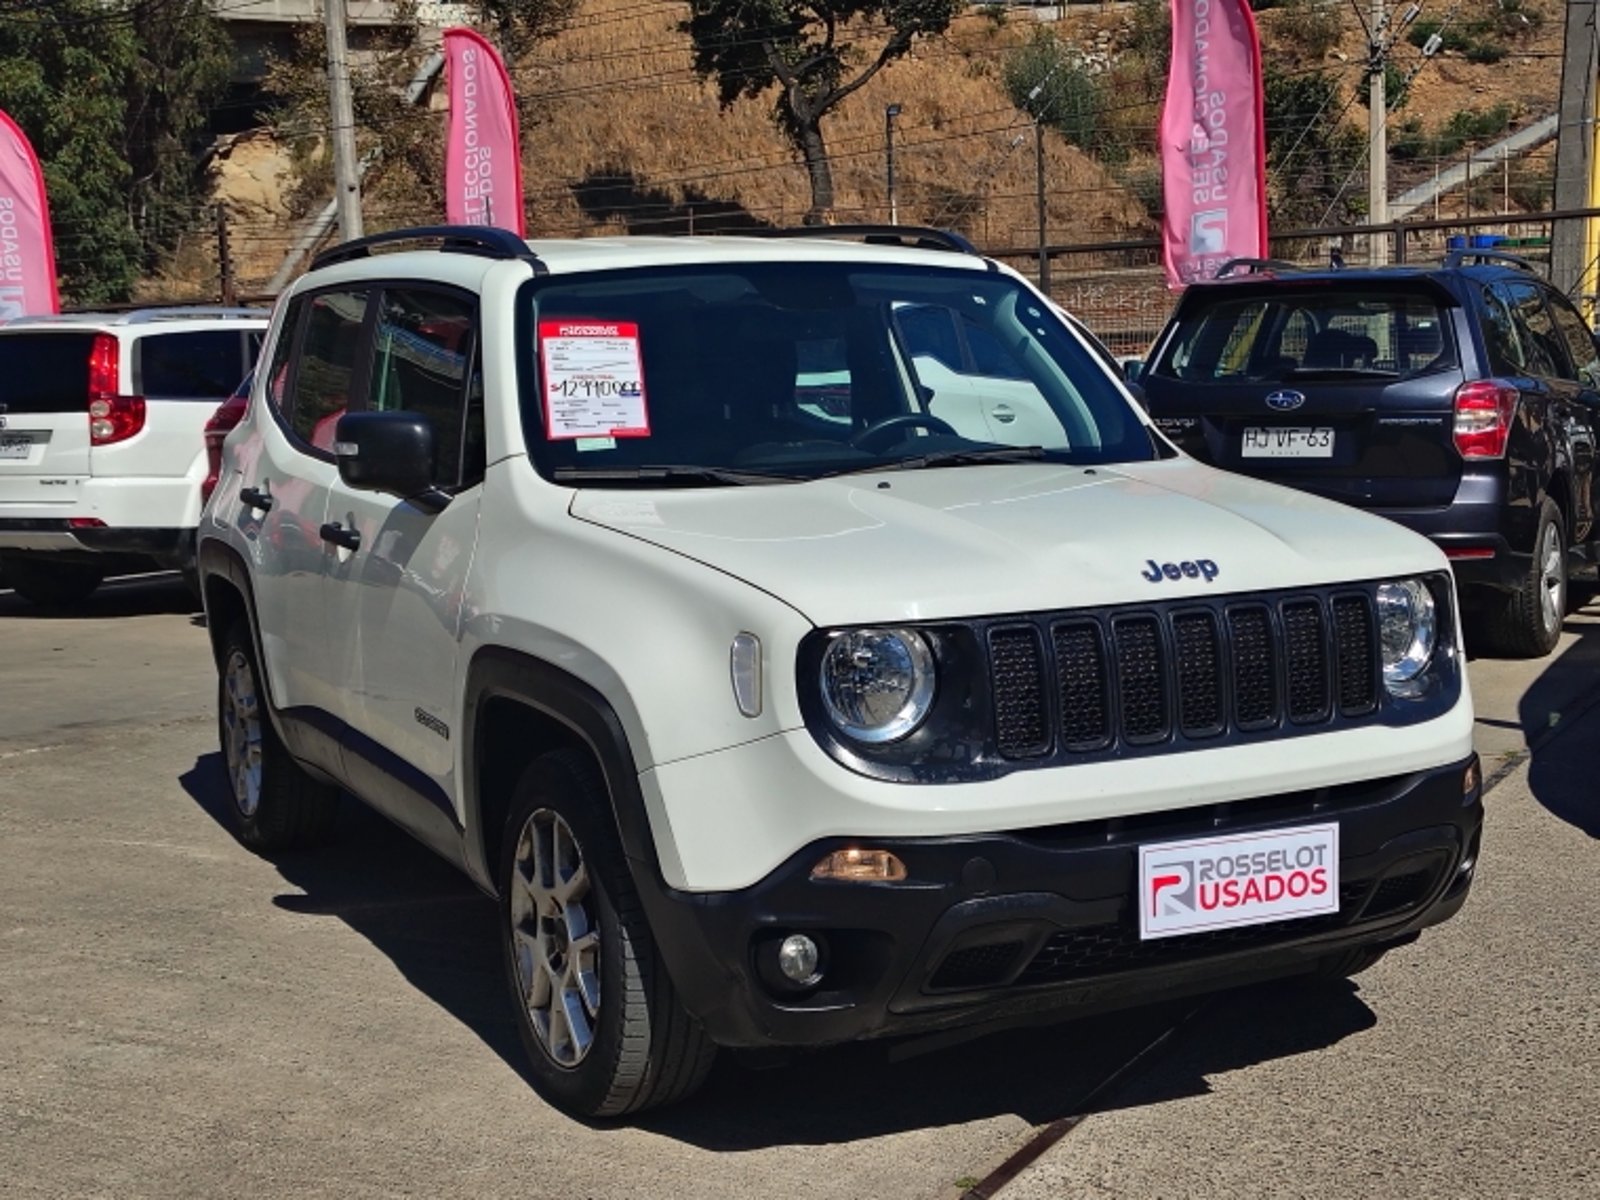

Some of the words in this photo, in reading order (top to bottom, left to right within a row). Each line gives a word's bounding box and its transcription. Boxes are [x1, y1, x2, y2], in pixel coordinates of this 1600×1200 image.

[1141, 559, 1219, 583] Jeep
[1199, 844, 1327, 881] ROSSELOT
[1199, 868, 1328, 911] USADOS
